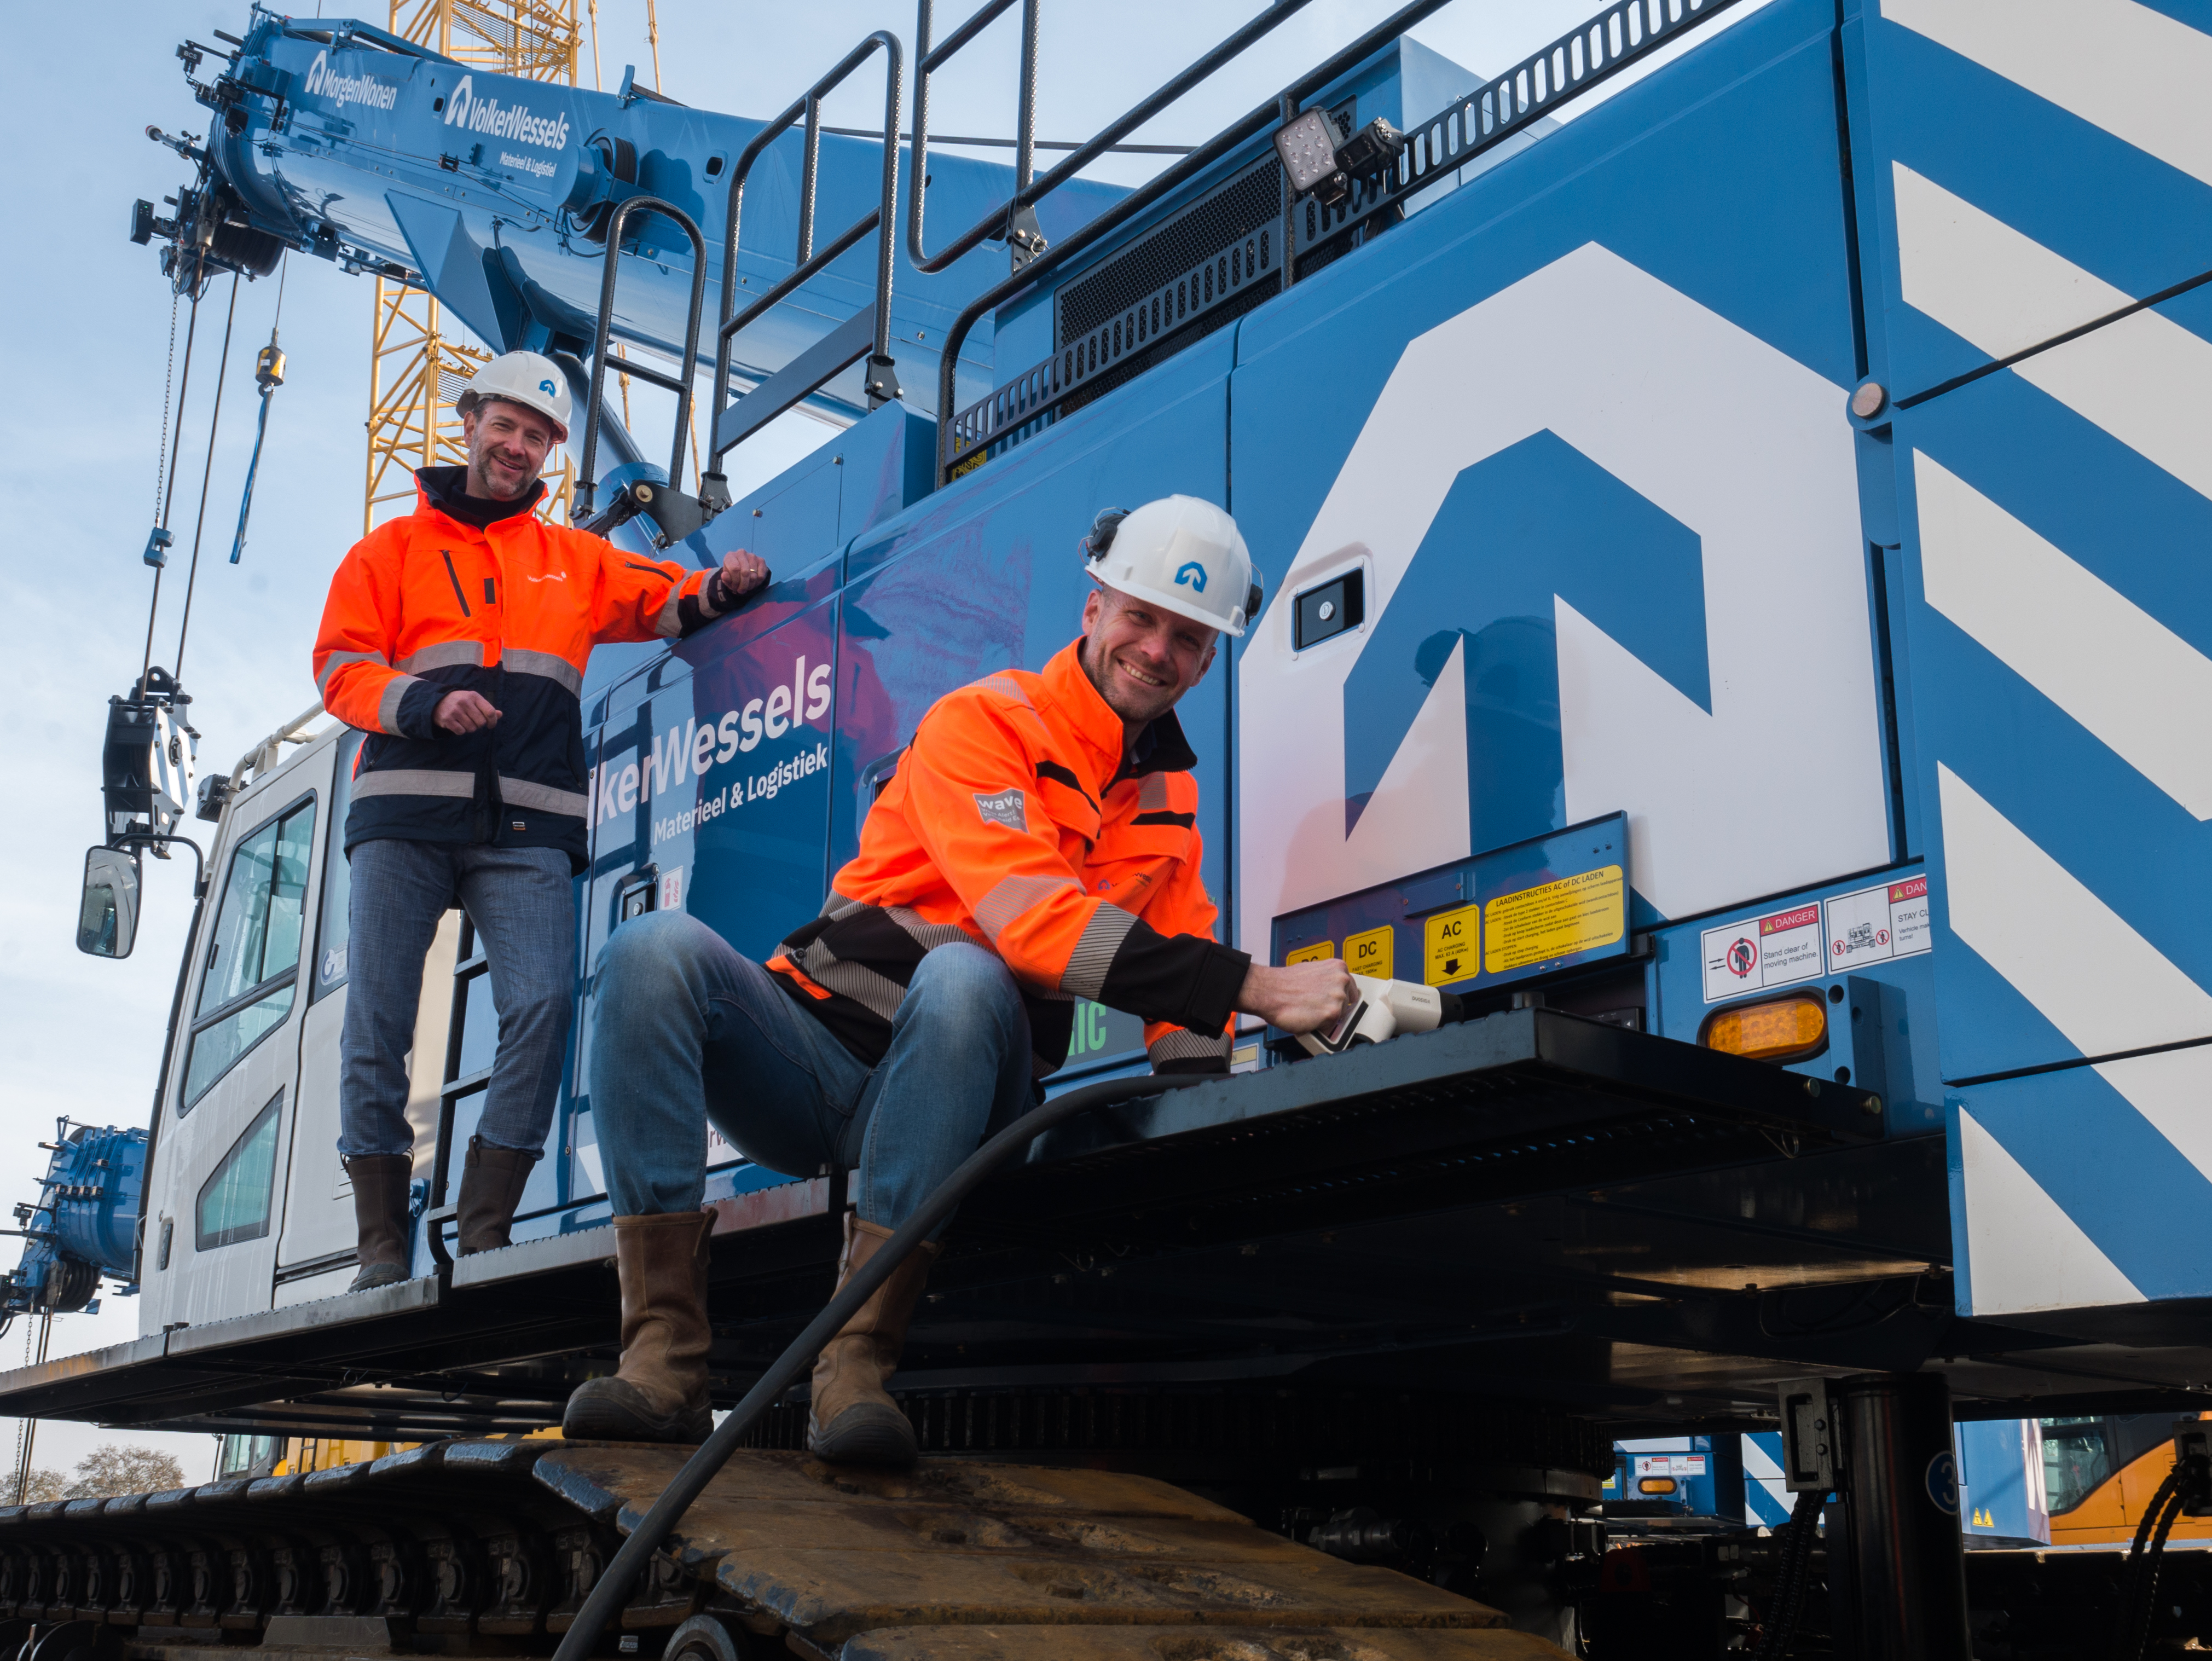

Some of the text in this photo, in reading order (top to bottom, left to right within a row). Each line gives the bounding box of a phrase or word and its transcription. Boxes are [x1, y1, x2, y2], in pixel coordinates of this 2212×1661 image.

[184, 50, 197, 60] BCS
[322, 68, 398, 110] MorgenWonen
[468, 97, 570, 151] VolkerWessels
[499, 151, 527, 170] Materieel
[525, 157, 531, 171] &
[586, 655, 831, 831] lkerWessels
[654, 743, 827, 846] Materieel & Logistiek
[977, 796, 1022, 810] wave
[1496, 871, 1604, 907] LAADINSTRUCTIES AC of DC LADEN
[1906, 881, 1927, 895] DAN
[1775, 910, 1815, 928] DANGER
[1898, 911, 1918, 922] STAY
[1441, 921, 1462, 940] AC
[1359, 941, 1377, 959] DC
[1444, 941, 1466, 951] CHARGING
[1763, 942, 1808, 959] Stand clear of
[1363, 960, 1382, 969] CHARGING
[1764, 952, 1819, 969] moving machine.
[1941, 1461, 1956, 1504] 3
